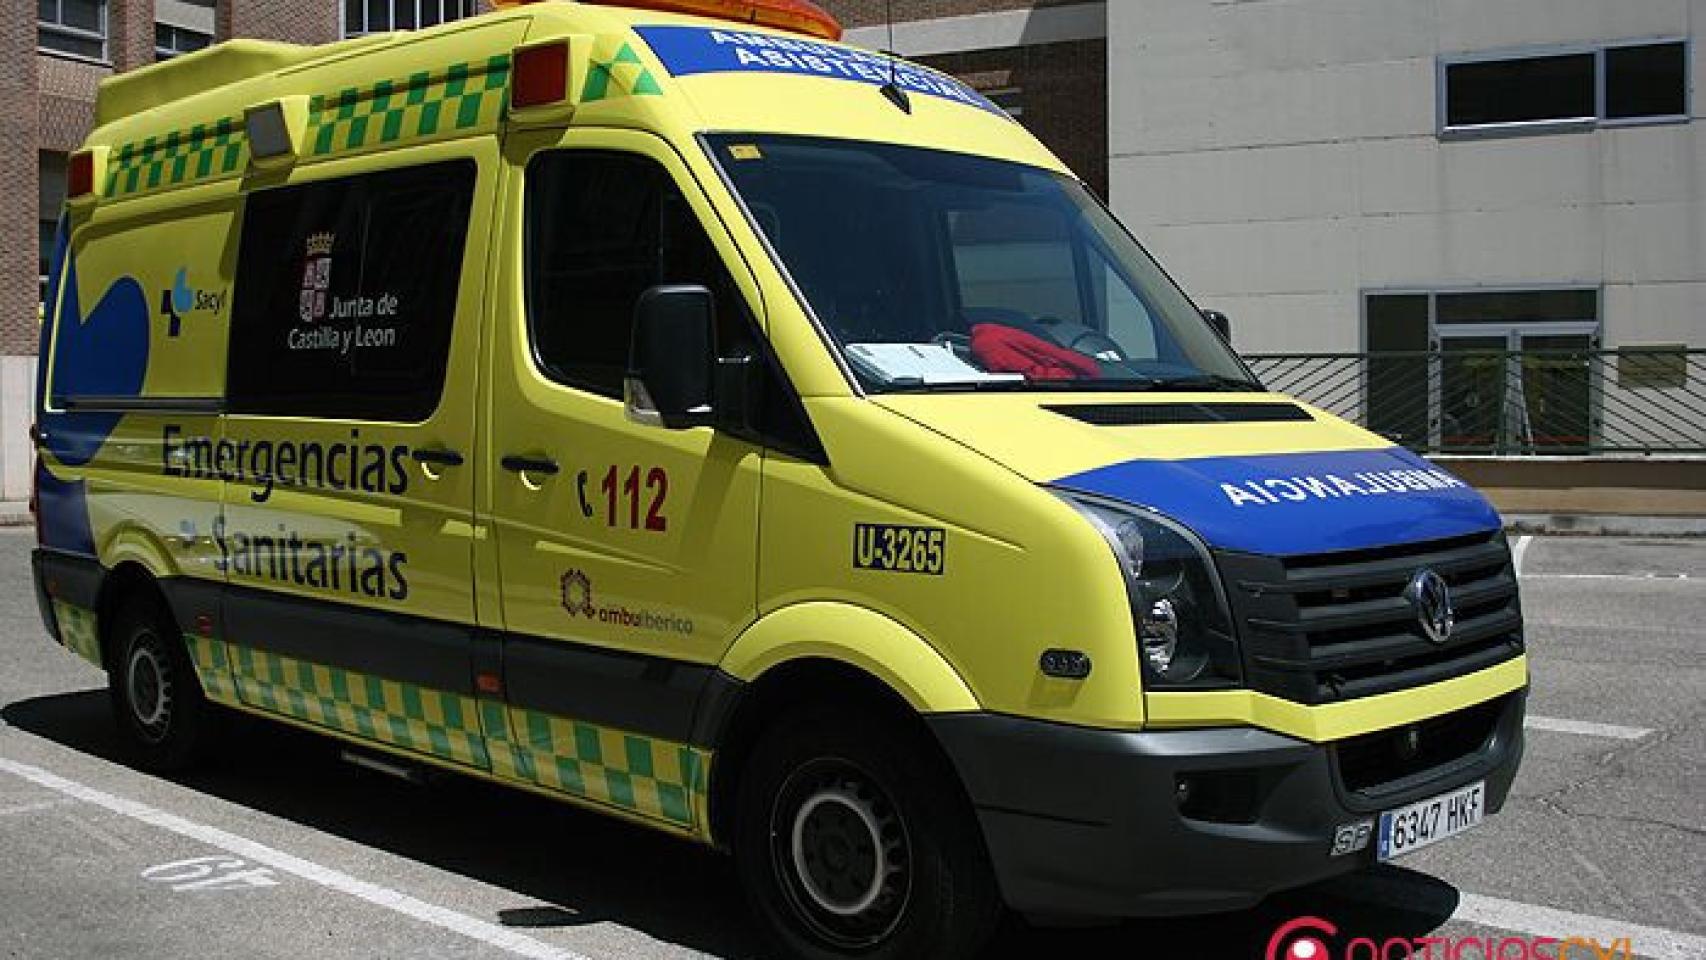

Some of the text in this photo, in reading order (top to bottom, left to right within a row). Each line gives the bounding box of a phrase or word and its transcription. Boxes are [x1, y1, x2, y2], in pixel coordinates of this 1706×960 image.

[329, 292, 398, 320] Junta de
[288, 325, 340, 350] Castilla
[341, 330, 354, 355] y
[162, 424, 409, 502] Emergencias
[601, 464, 669, 531] 112
[211, 515, 409, 600] Sanitarias
[857, 525, 942, 574] U-3265
[1336, 825, 1371, 854] SP
[1393, 787, 1480, 849] 6347 HKF
